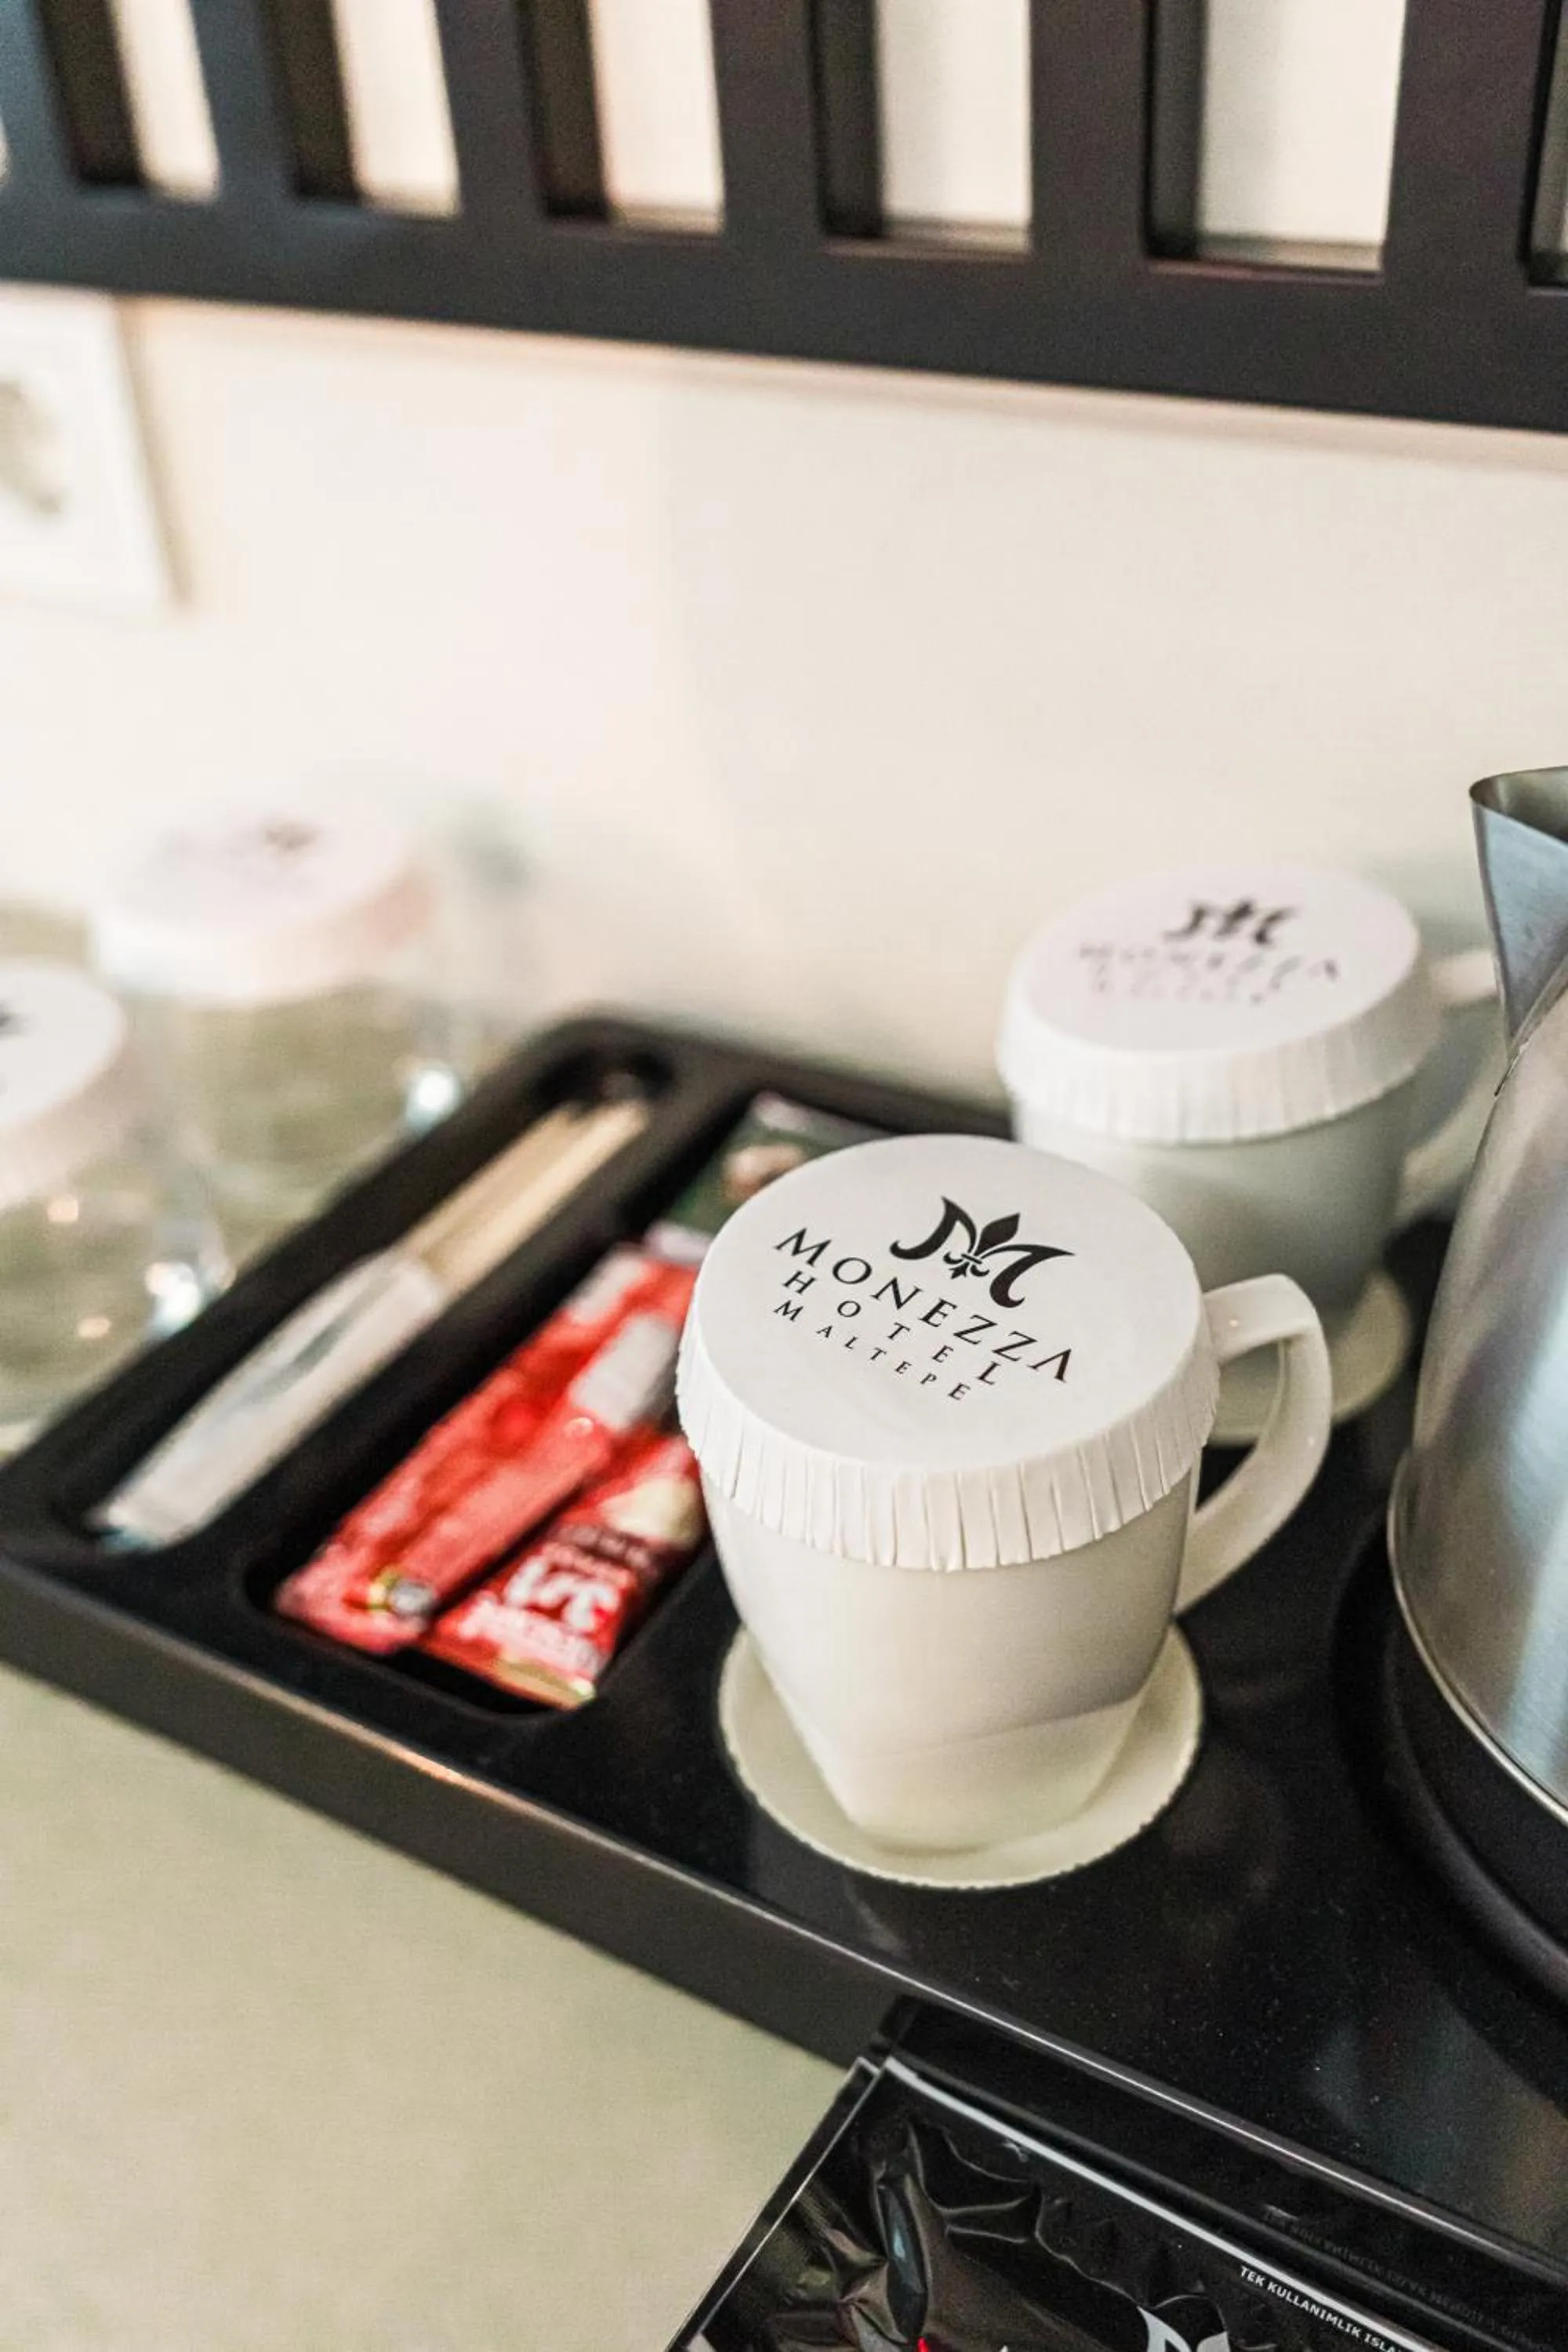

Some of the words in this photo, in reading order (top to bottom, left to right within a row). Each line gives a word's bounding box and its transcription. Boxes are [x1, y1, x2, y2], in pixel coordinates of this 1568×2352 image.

[772, 1299, 971, 1401] MALTEPE
[773, 1228, 1073, 1383] MONEZZA
[782, 1270, 1002, 1385] HOTEL
[1240, 2265, 1266, 2287] TEK
[1267, 2281, 1362, 2339] KULLANIMLIK
